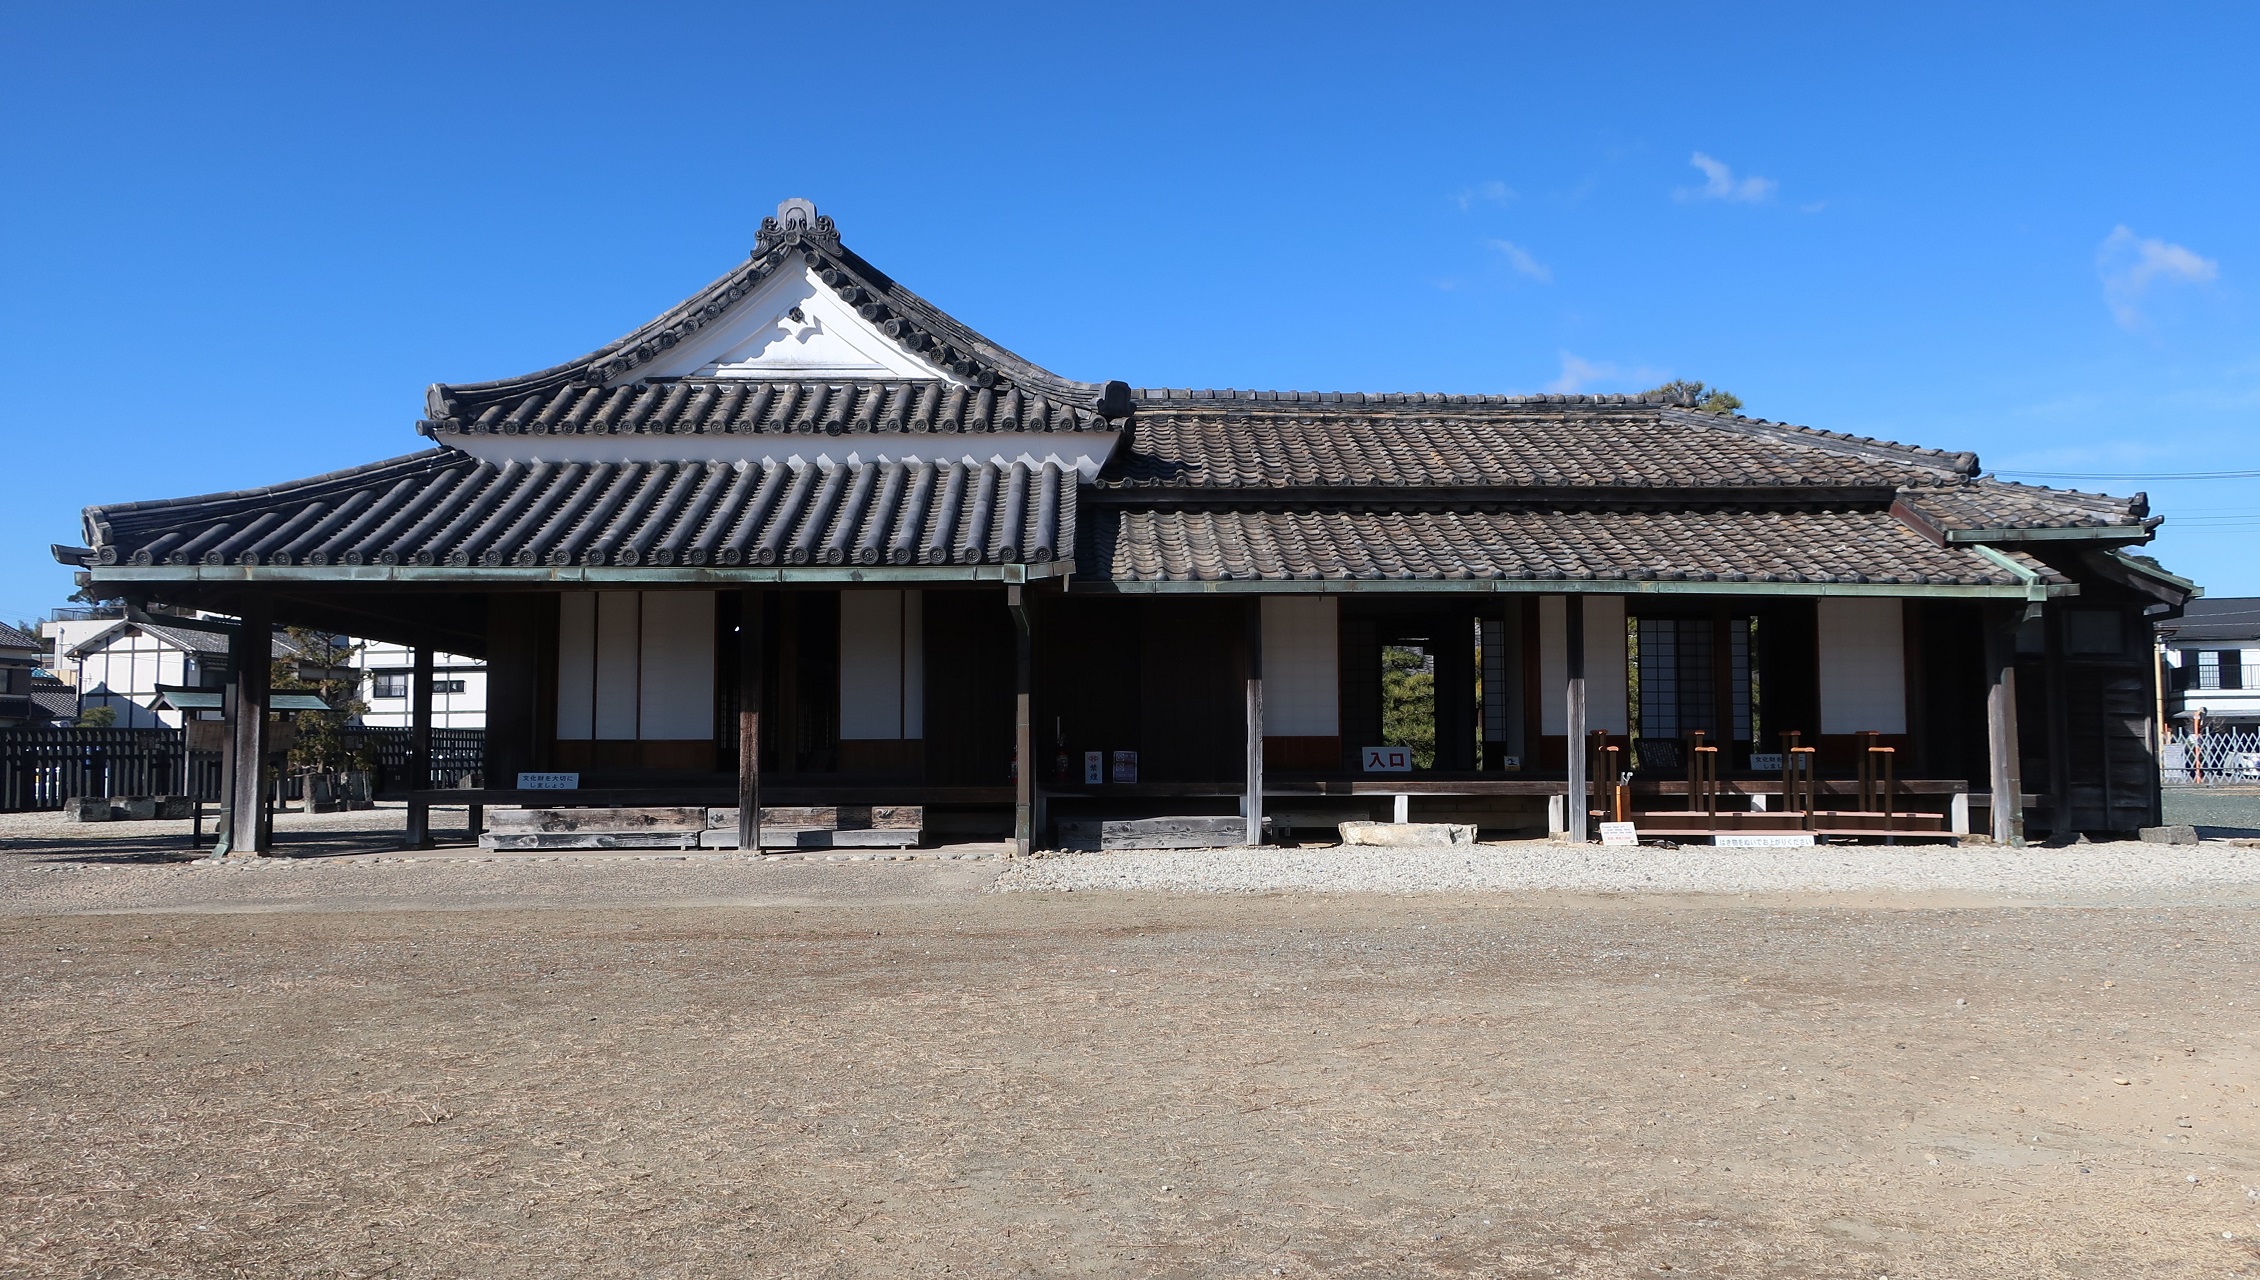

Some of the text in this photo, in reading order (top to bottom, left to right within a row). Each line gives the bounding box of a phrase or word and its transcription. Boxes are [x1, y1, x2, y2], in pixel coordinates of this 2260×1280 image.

[1368, 752, 1405, 768] 入口
[1089, 763, 1098, 781] 禁煙
[1719, 838, 1812, 847] はき物をぬいでお上がりください
